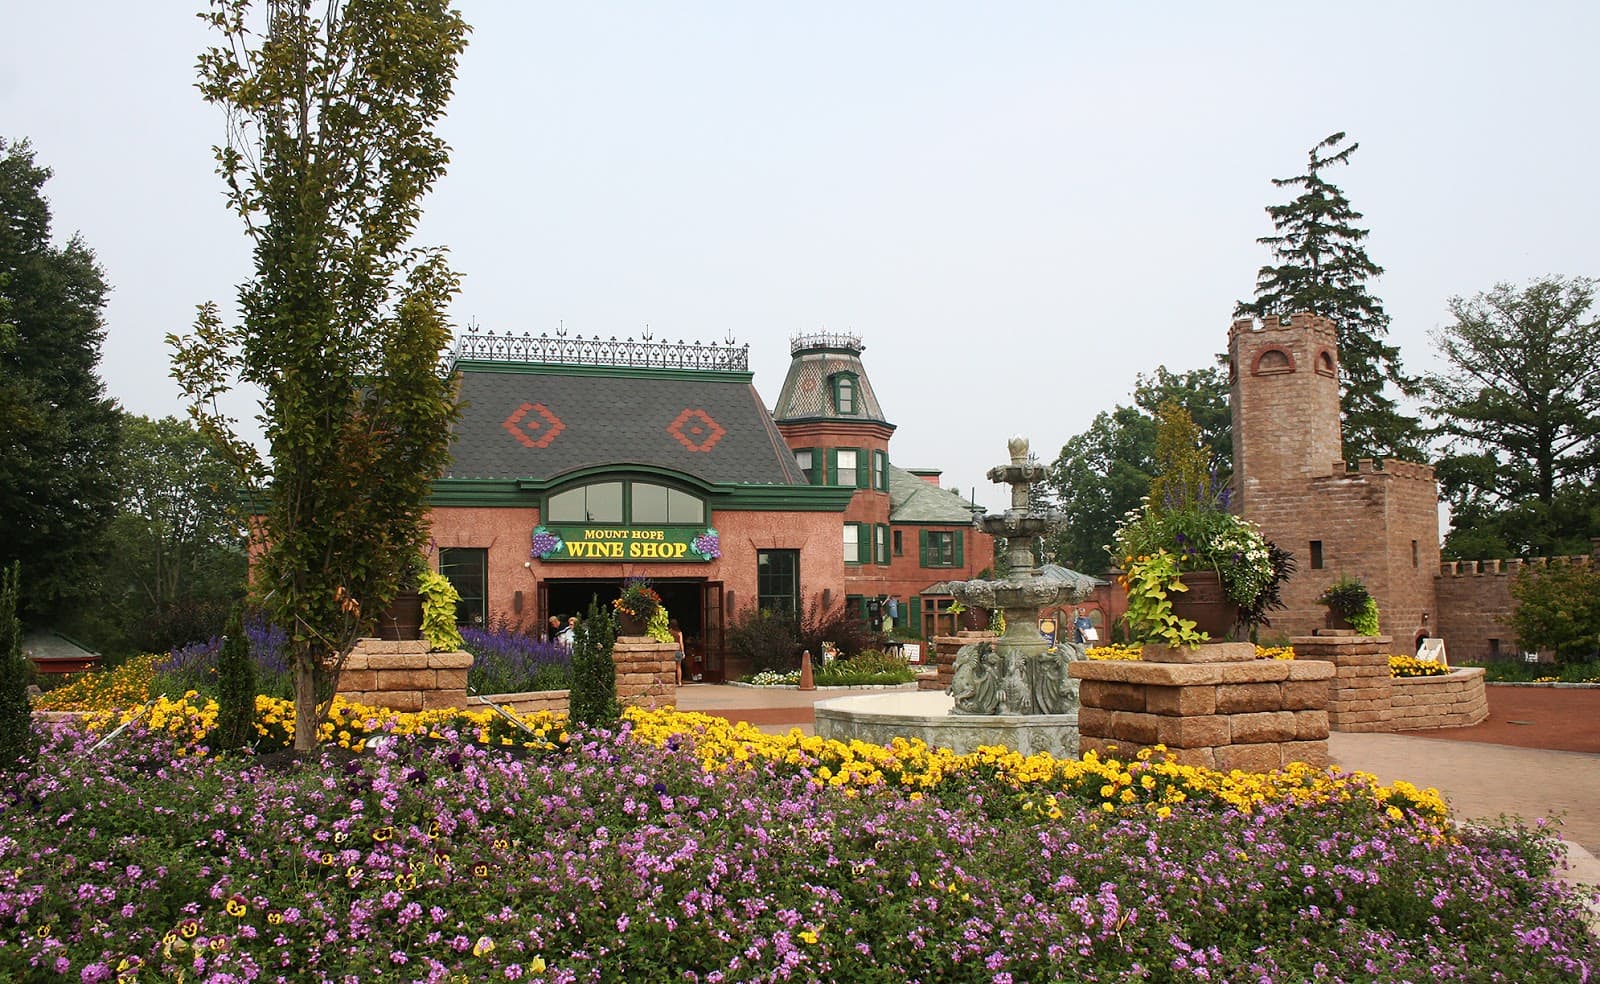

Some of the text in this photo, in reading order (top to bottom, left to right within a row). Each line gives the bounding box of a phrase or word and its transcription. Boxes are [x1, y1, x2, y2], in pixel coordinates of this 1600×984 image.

[585, 529, 664, 540] MOUNT HOPE
[565, 541, 688, 558] WINE SHOP
